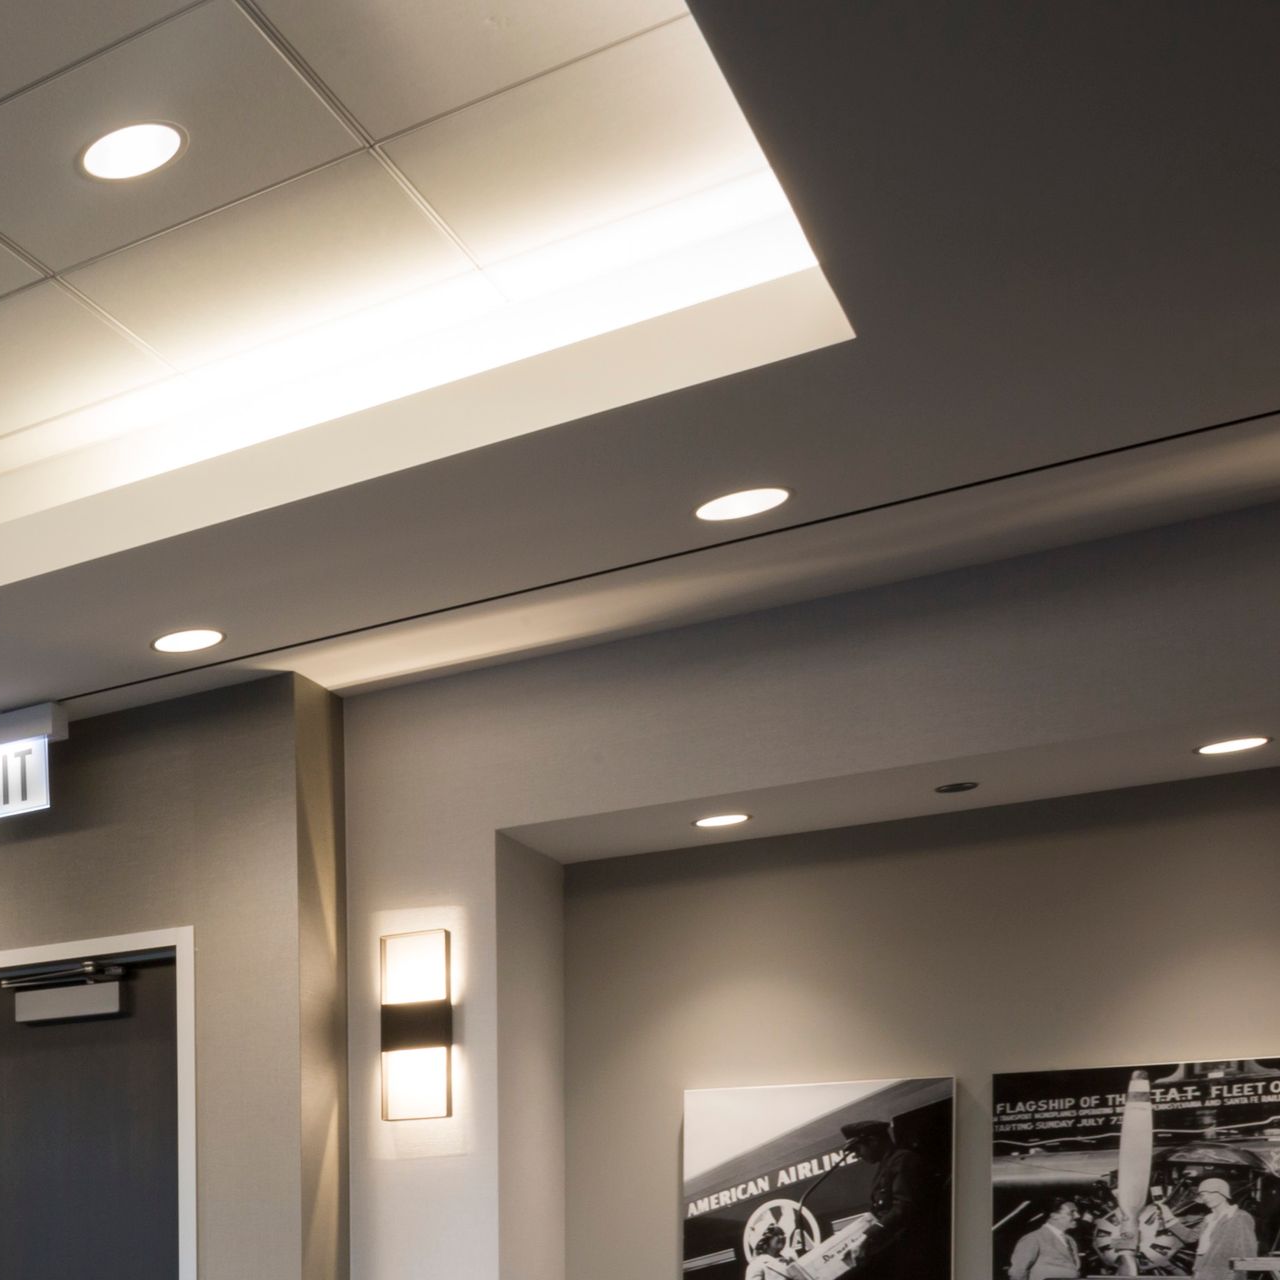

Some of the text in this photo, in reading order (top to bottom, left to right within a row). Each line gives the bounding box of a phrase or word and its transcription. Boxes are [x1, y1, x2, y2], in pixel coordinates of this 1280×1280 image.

[996, 1098, 1075, 1114] FLAGSHIP
[1079, 1095, 1100, 1108] OF
[1105, 1093, 1127, 1106] TH
[1211, 1081, 1266, 1098] FLEET
[1269, 1080, 1280, 1093] O
[994, 1122, 1033, 1132] TARTING
[1035, 1119, 1075, 1130] SUNDAY
[1077, 1117, 1105, 1127] JULY
[687, 1150, 861, 1218] AMERICAN AIRLINE
